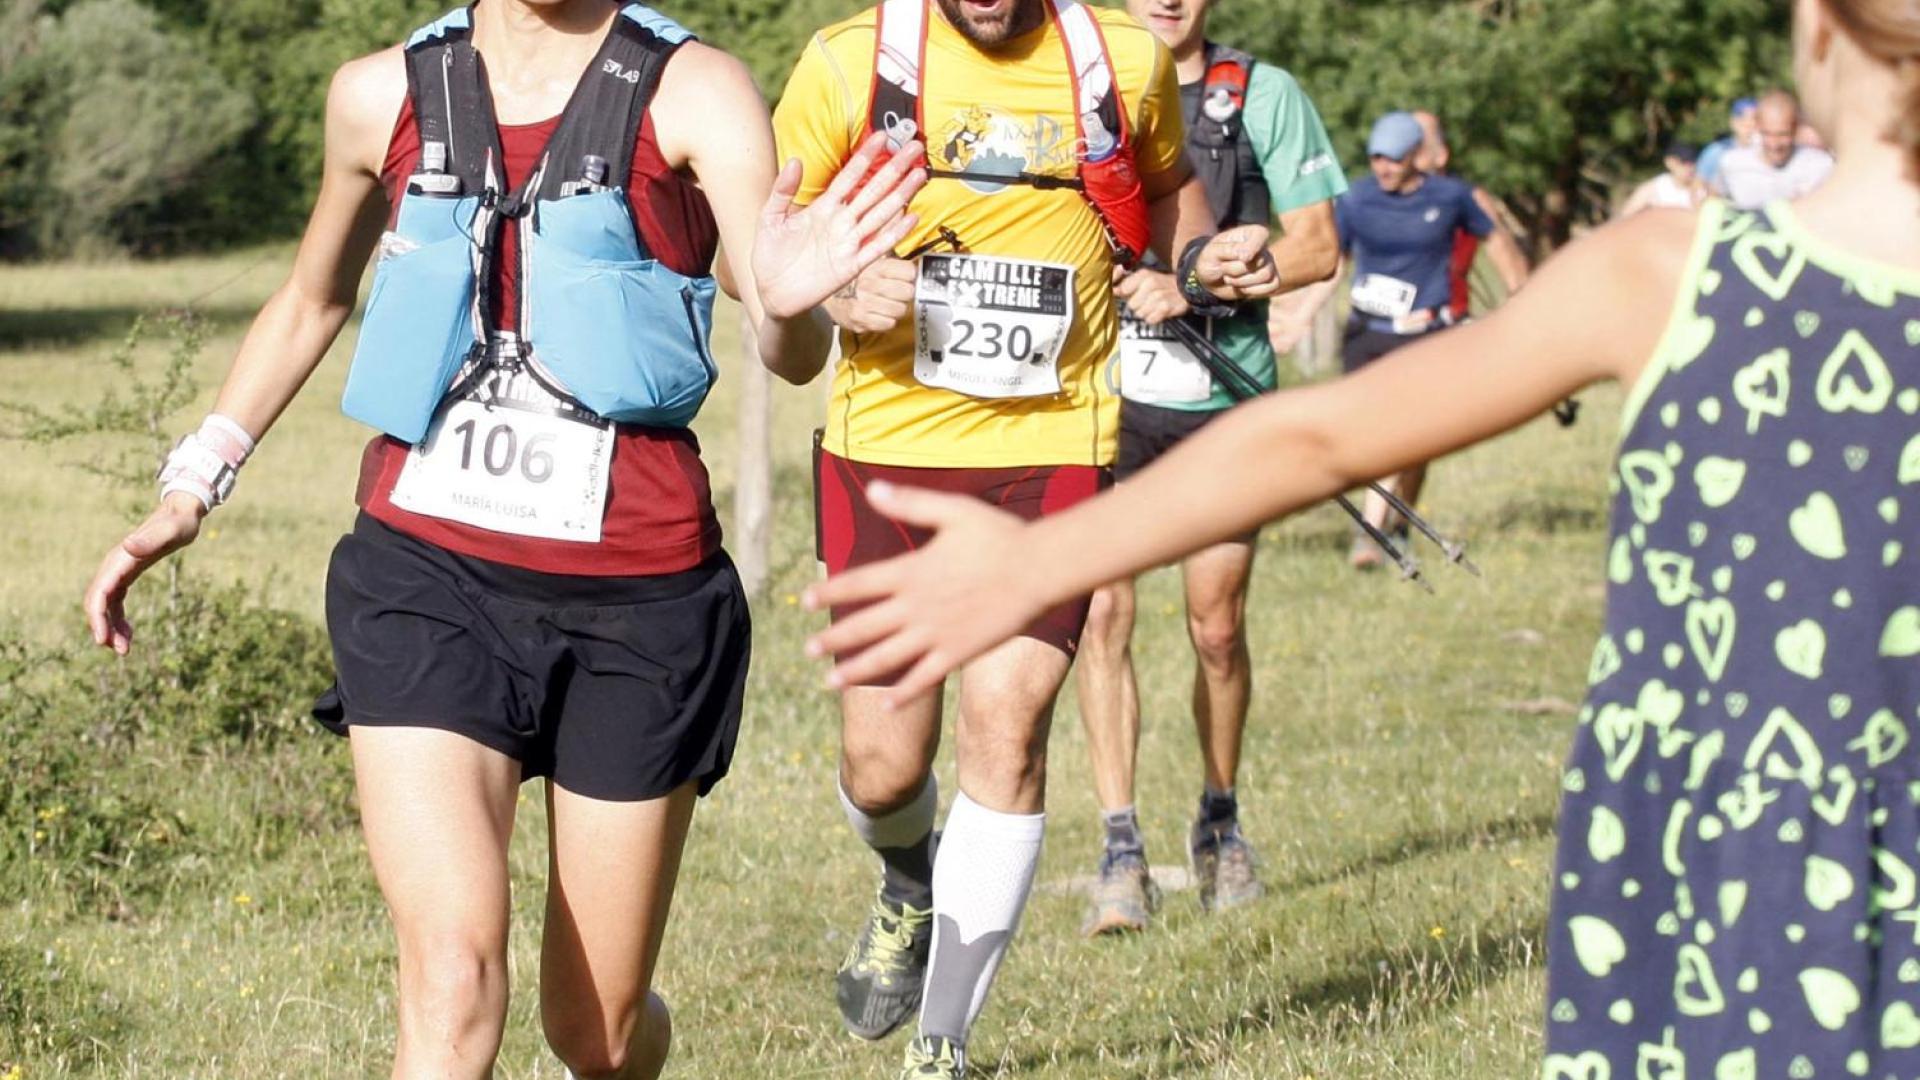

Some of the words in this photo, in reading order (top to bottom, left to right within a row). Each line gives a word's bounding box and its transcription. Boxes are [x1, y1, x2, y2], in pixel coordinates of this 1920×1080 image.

[949, 257, 1043, 287] CAMILLE
[948, 279, 1041, 309] EXTREME
[949, 319, 1032, 362] 230
[1138, 350, 1158, 376] 7
[454, 418, 558, 484] 106
[494, 501, 538, 519] LUISA
